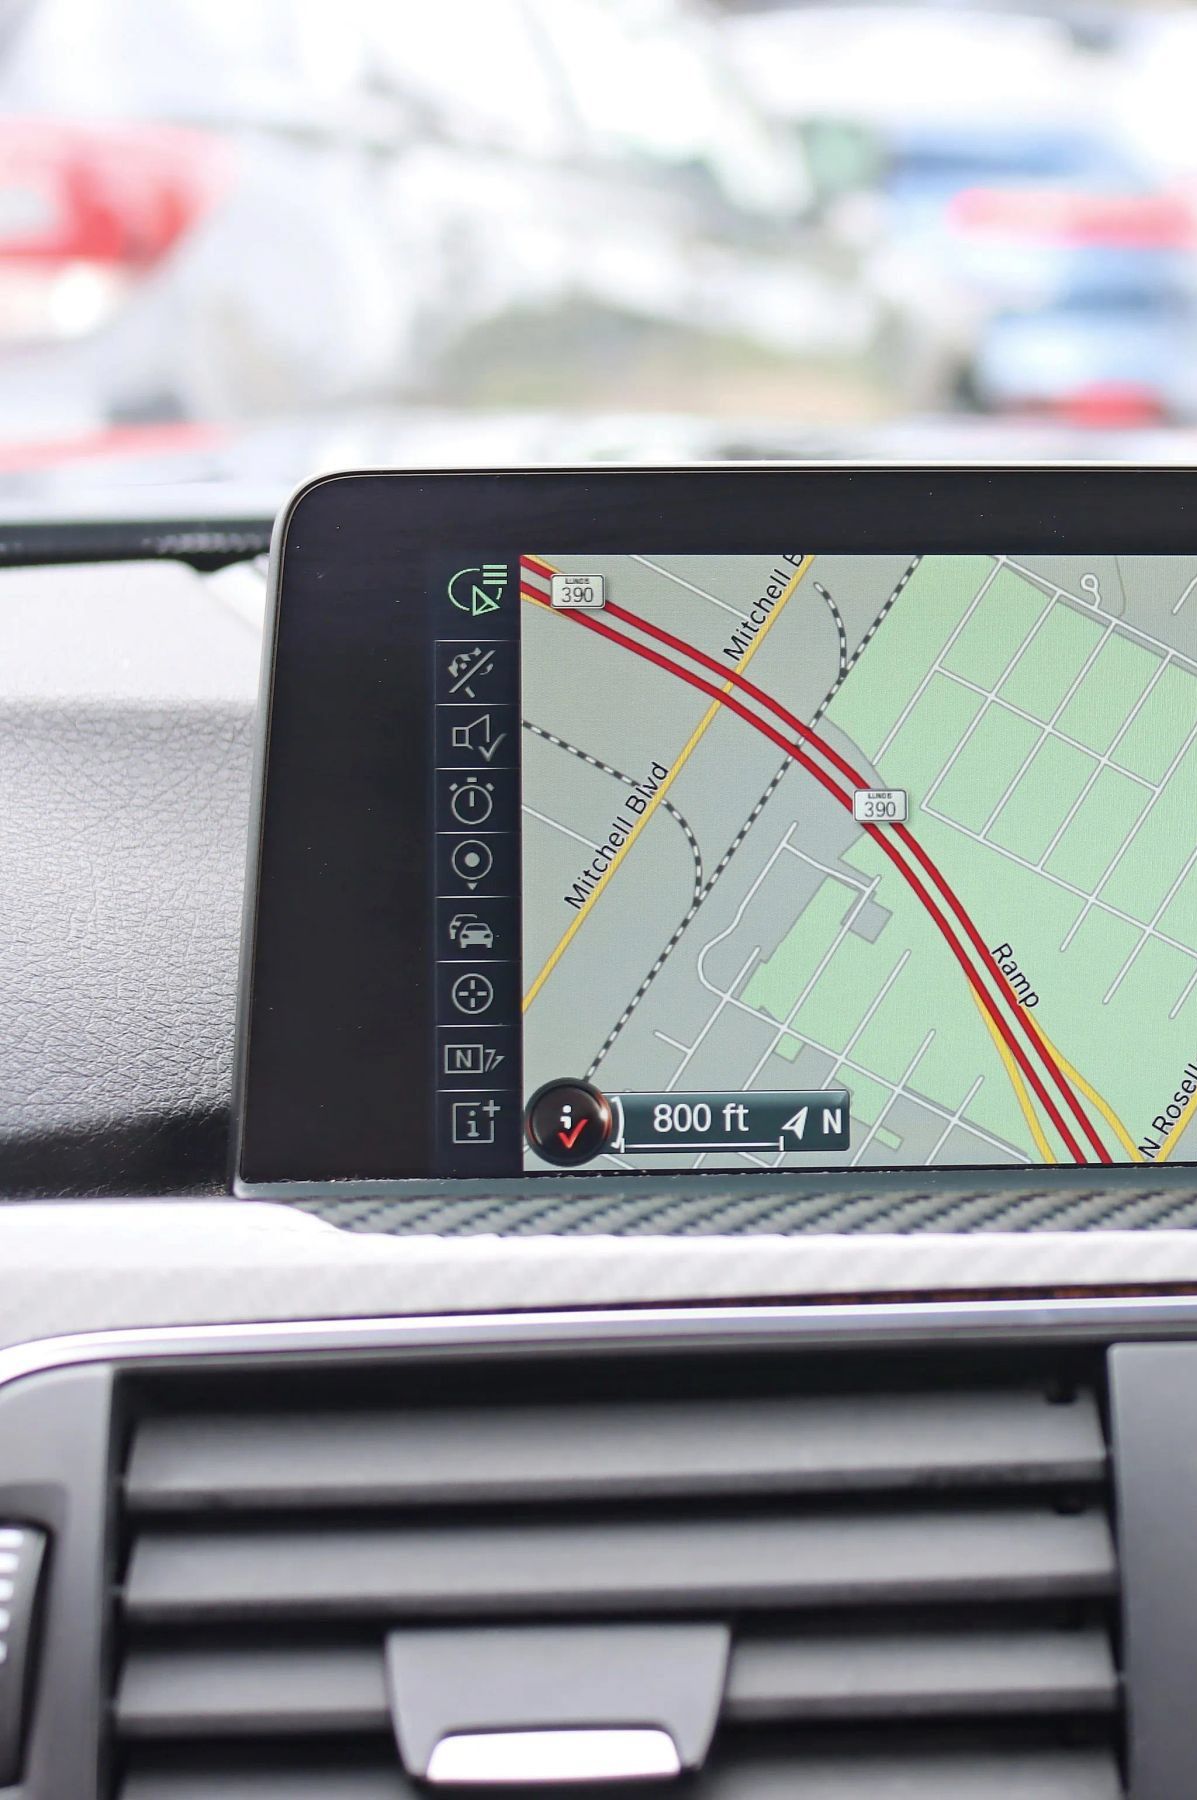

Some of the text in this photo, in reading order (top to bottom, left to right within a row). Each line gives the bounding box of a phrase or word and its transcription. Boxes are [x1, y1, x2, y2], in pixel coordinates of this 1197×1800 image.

[562, 587, 593, 603] 390
[723, 568, 791, 661] Mitchell
[865, 801, 896, 817] 390
[564, 761, 669, 909] Mitchell Blvd
[991, 943, 1039, 1007] Ramp
[653, 1103, 749, 1132] 800 ft
[823, 1108, 842, 1134] N
[1138, 1137, 1161, 1158] N
